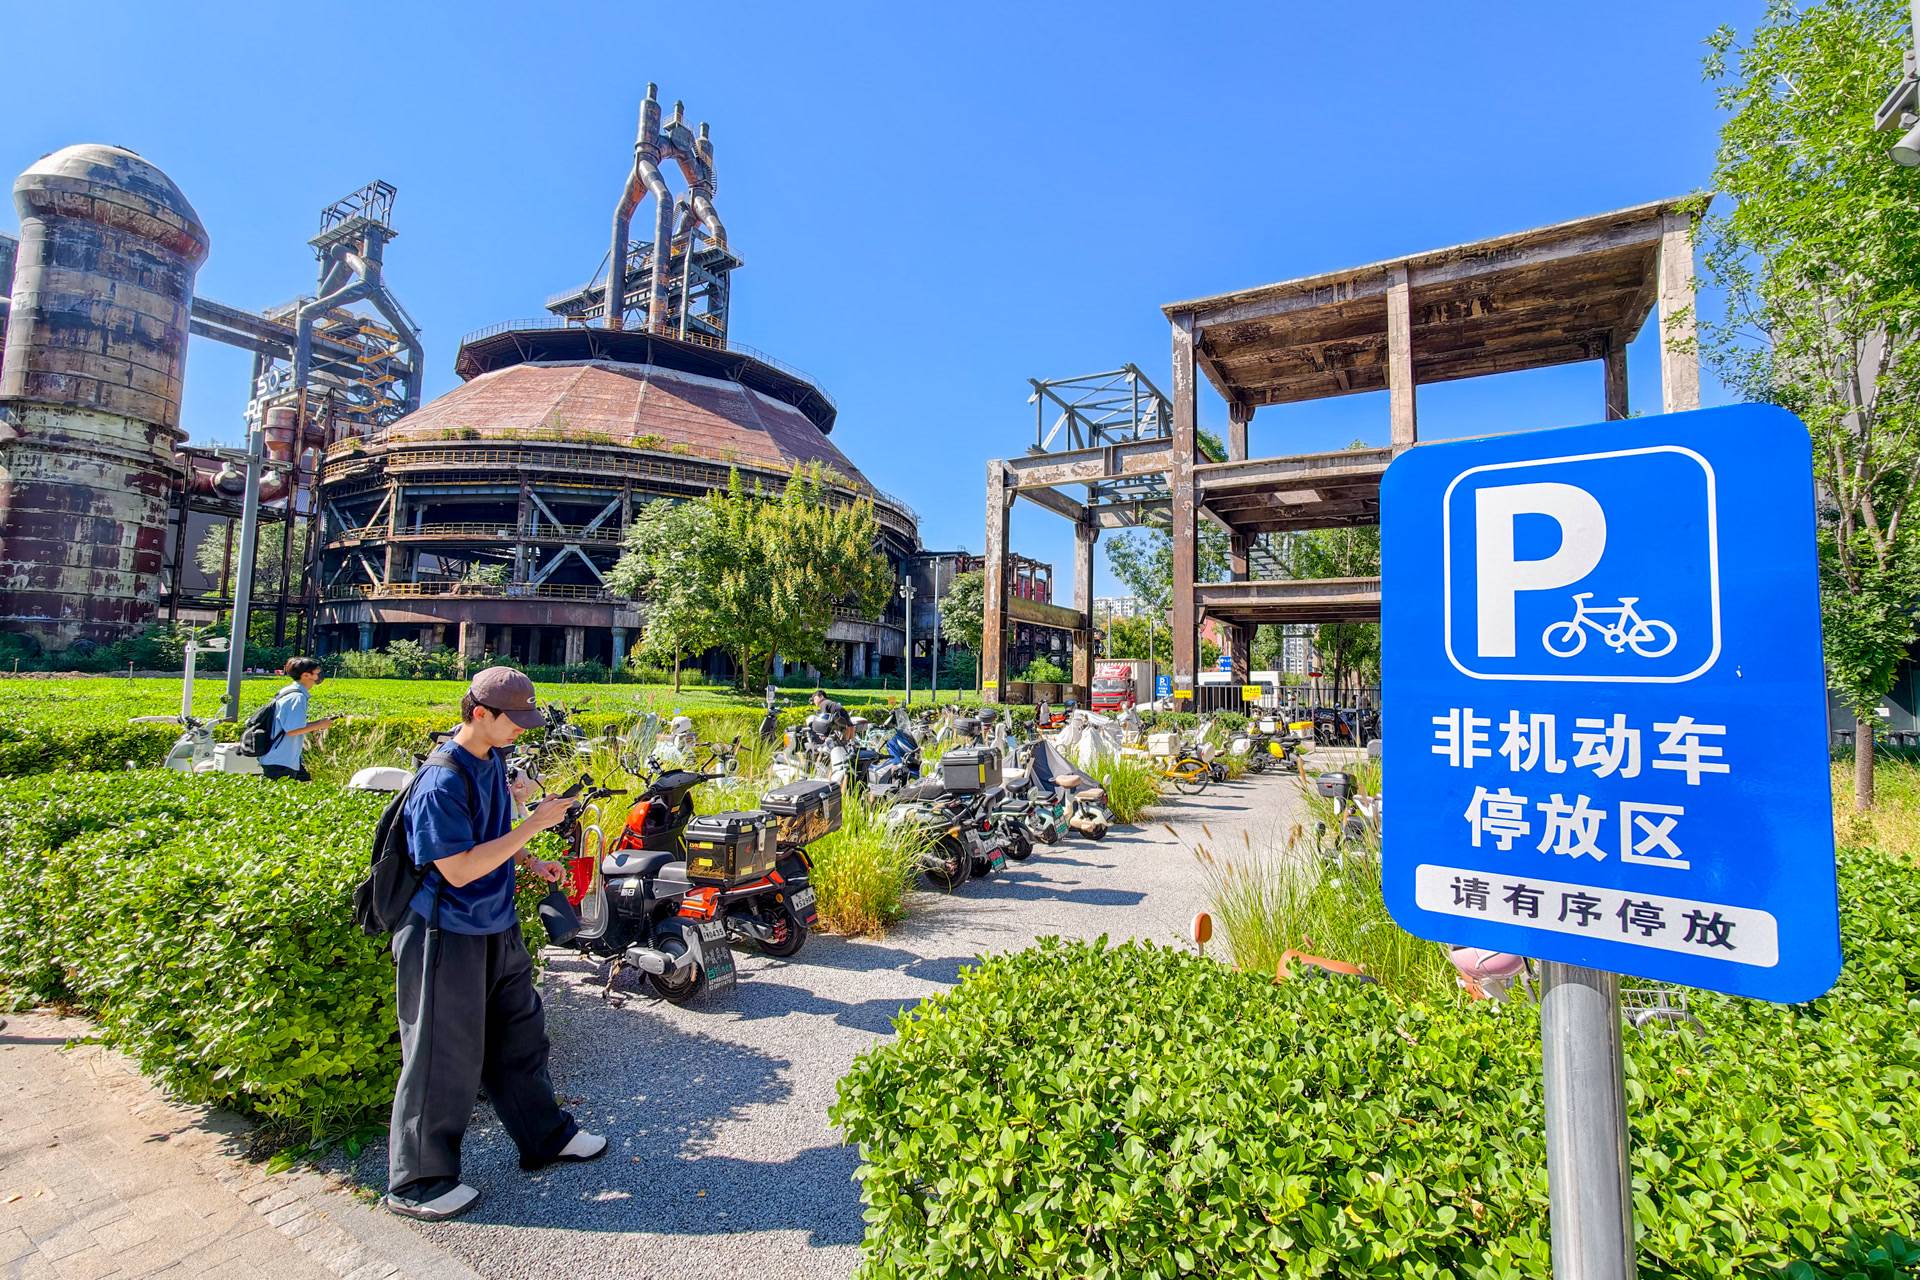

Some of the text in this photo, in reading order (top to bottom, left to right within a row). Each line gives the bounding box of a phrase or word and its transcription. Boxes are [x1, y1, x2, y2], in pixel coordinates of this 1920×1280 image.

[1475, 482, 1607, 658] P
[1431, 707, 1730, 786] 非机动车
[1463, 785, 1691, 870] 停放区
[1450, 876, 1737, 951] 请有序停放
